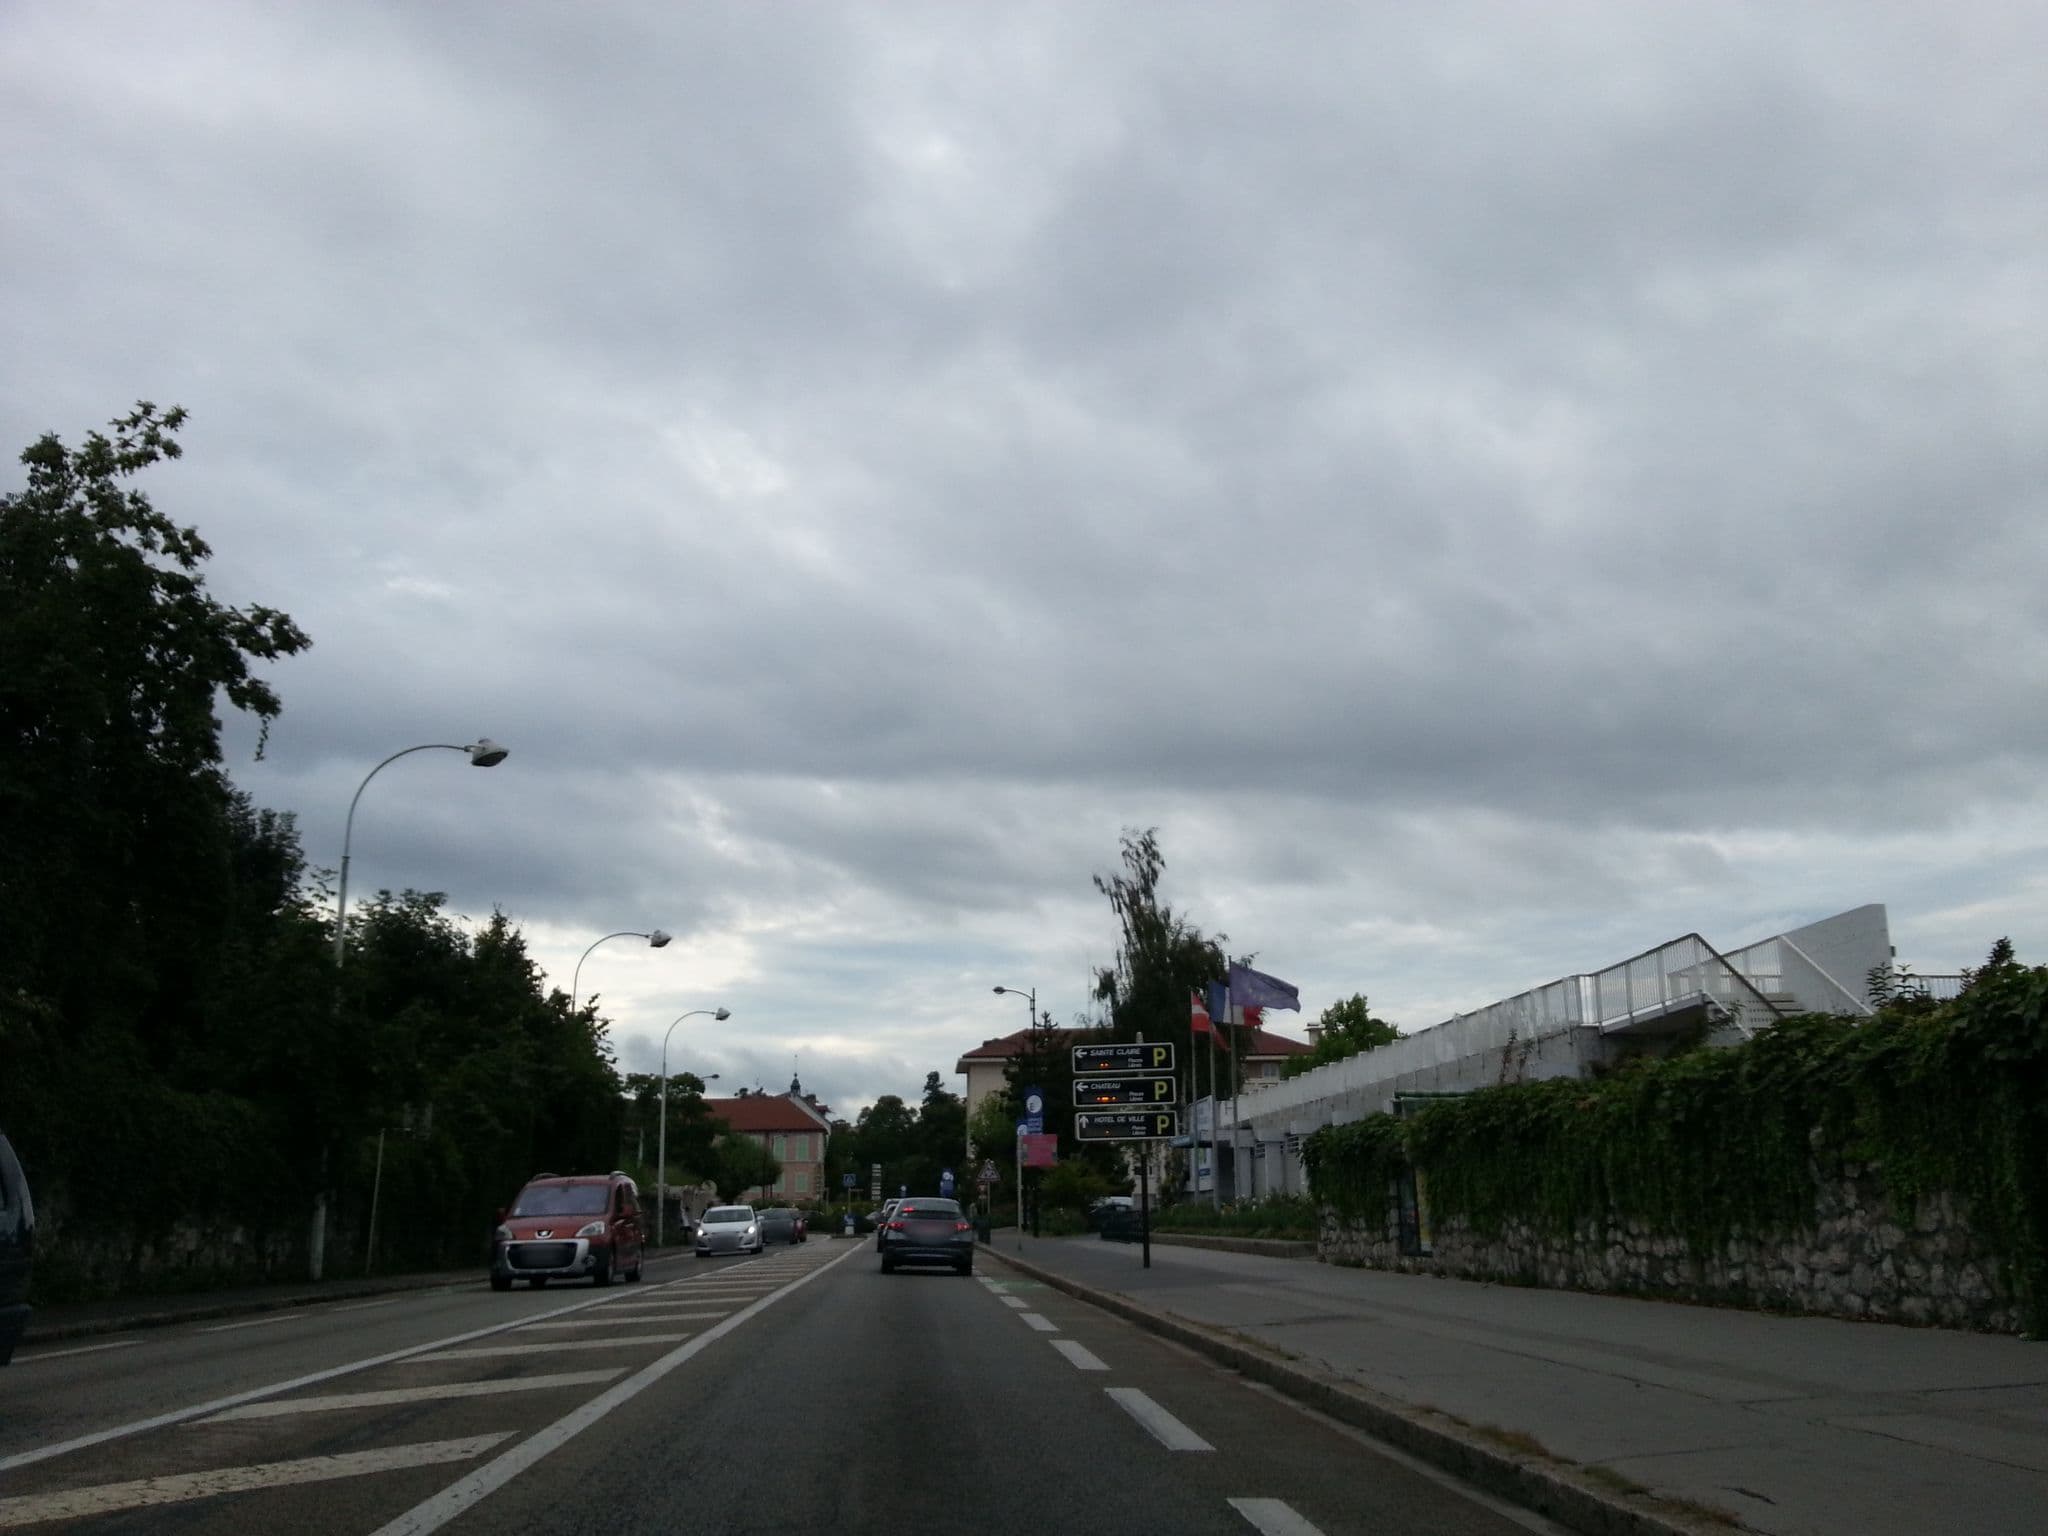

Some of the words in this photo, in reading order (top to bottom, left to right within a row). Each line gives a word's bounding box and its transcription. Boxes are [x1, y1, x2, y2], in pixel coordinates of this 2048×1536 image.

[1116, 1048, 1141, 1056] CLAIRE
[1153, 1047, 1167, 1067] P
[1154, 1081, 1168, 1101] P
[1157, 1115, 1170, 1135] P
